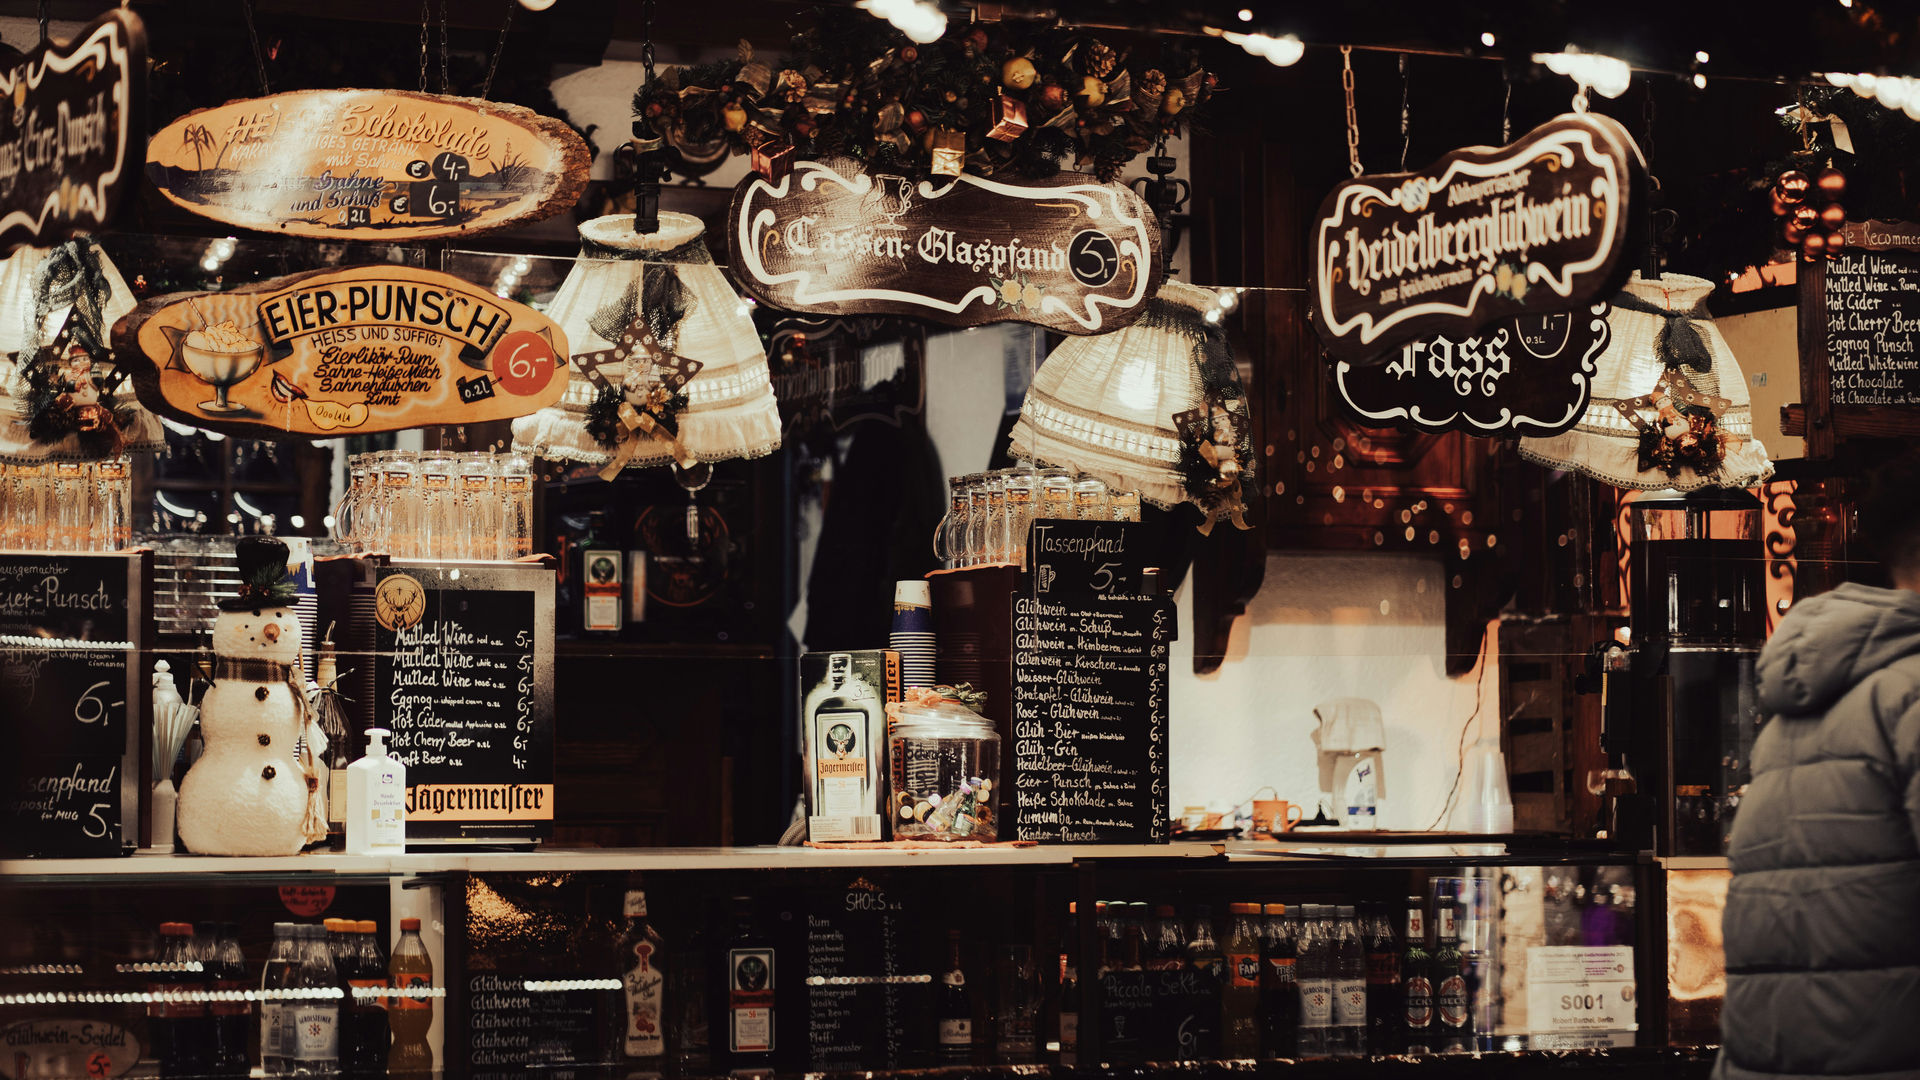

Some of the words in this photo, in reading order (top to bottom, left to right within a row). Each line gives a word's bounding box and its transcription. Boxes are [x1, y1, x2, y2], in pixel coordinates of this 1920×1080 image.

[338, 104, 490, 160] Schokolade
[326, 153, 352, 168] mit
[411, 161, 426, 177] €
[290, 193, 323, 213] und
[393, 196, 407, 212] €
[1075, 237, 1118, 279] 5,-
[1826, 255, 1867, 274] Mulled
[1870, 256, 1897, 274] Wine
[1825, 276, 1862, 293] Mulled
[1863, 276, 1889, 292] Wine
[1826, 294, 1844, 310] Hot
[1847, 293, 1882, 310] Cider
[265, 285, 500, 346] EIER-PUNSCH
[1827, 313, 1846, 332] Hot
[1849, 312, 1891, 336] Cherry
[311, 329, 357, 348] HEISS
[362, 327, 389, 341] UND
[394, 328, 443, 348] SÜFFIG!
[1874, 332, 1914, 353] Punsch
[509, 343, 548, 378] 6,-
[1848, 371, 1904, 388] Chocolate
[1848, 389, 1892, 404] Chocolate
[1036, 525, 1125, 563] Tassenpfand
[1015, 598, 1067, 616] Glühwein
[1152, 609, 1168, 625] 5,-
[394, 620, 440, 646] Mulled
[441, 620, 474, 646] Wine
[515, 630, 533, 648] 5,-
[1015, 617, 1066, 632] Glühwein
[1080, 619, 1112, 638] Schuß
[1152, 626, 1168, 641] 6,-
[1015, 634, 1065, 650] Glühwein
[1078, 635, 1121, 652] Himbeeren
[392, 646, 441, 668] Mulled
[441, 647, 474, 669] Wine
[517, 655, 535, 673] 5,-
[1074, 653, 1117, 670] Kirschen
[392, 669, 439, 686] Mulled
[441, 669, 472, 687] Wine
[518, 676, 536, 695] 6,-
[1149, 678, 1164, 694] 5,-
[75, 680, 125, 727] 6,-
[391, 688, 433, 711] Eggnog
[517, 696, 535, 715] 6,-
[1149, 694, 1162, 709] 6,-
[391, 709, 414, 730] Hot
[417, 711, 446, 728] Cider
[516, 715, 535, 733] 6,-
[1151, 710, 1165, 726] 6,-
[390, 731, 411, 747] Hot
[414, 731, 446, 752] Cherry
[447, 731, 475, 748] Beer
[1150, 726, 1163, 744] 6,-
[422, 750, 446, 764] Beer
[512, 754, 527, 769] 4,-
[1149, 745, 1163, 759] 6,-
[1151, 761, 1164, 775] 6,-
[1152, 779, 1167, 796] 6,-
[1017, 791, 1047, 809] Heiße
[55, 810, 79, 820] MUG
[1017, 807, 1073, 824] Lumumba
[1153, 814, 1167, 827] 6,-
[808, 915, 830, 928] Rum
[470, 975, 524, 992] Glühwei
[1104, 975, 1153, 998] Piccolo
[471, 993, 531, 1010] Glühwein
[1561, 994, 1604, 1010] S001
[471, 1013, 531, 1029] Glühwein
[1598, 1016, 1614, 1024] Berlin
[471, 1032, 529, 1049] Glühwein
[471, 1049, 528, 1065] Glühwein
